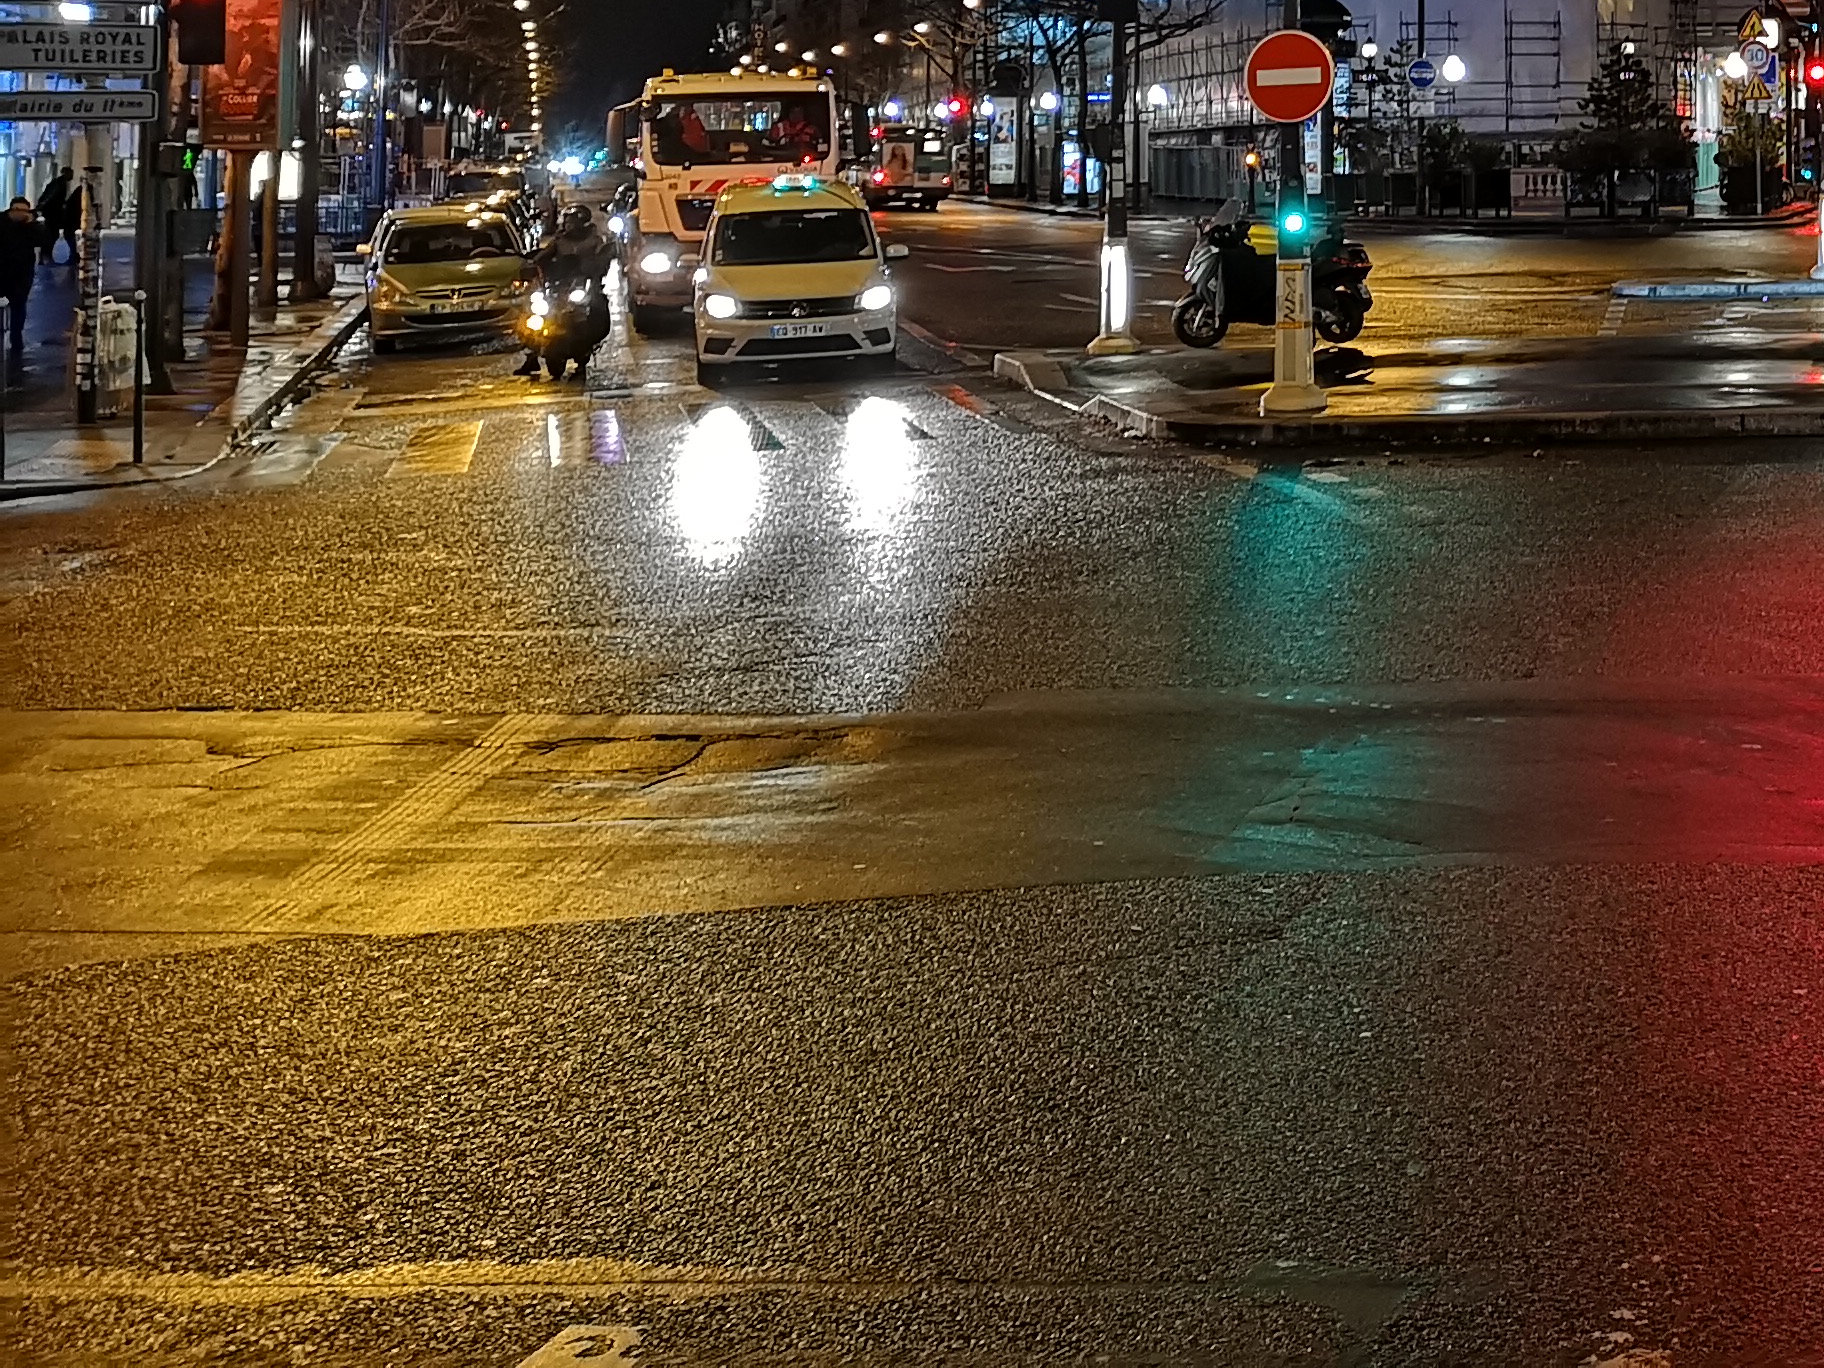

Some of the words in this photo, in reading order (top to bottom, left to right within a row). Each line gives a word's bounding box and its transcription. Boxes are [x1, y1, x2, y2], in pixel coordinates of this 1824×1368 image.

[80, 31, 146, 46] ROYAL
[32, 48, 145, 64] TUILERIES
[73, 99, 94, 113] du
